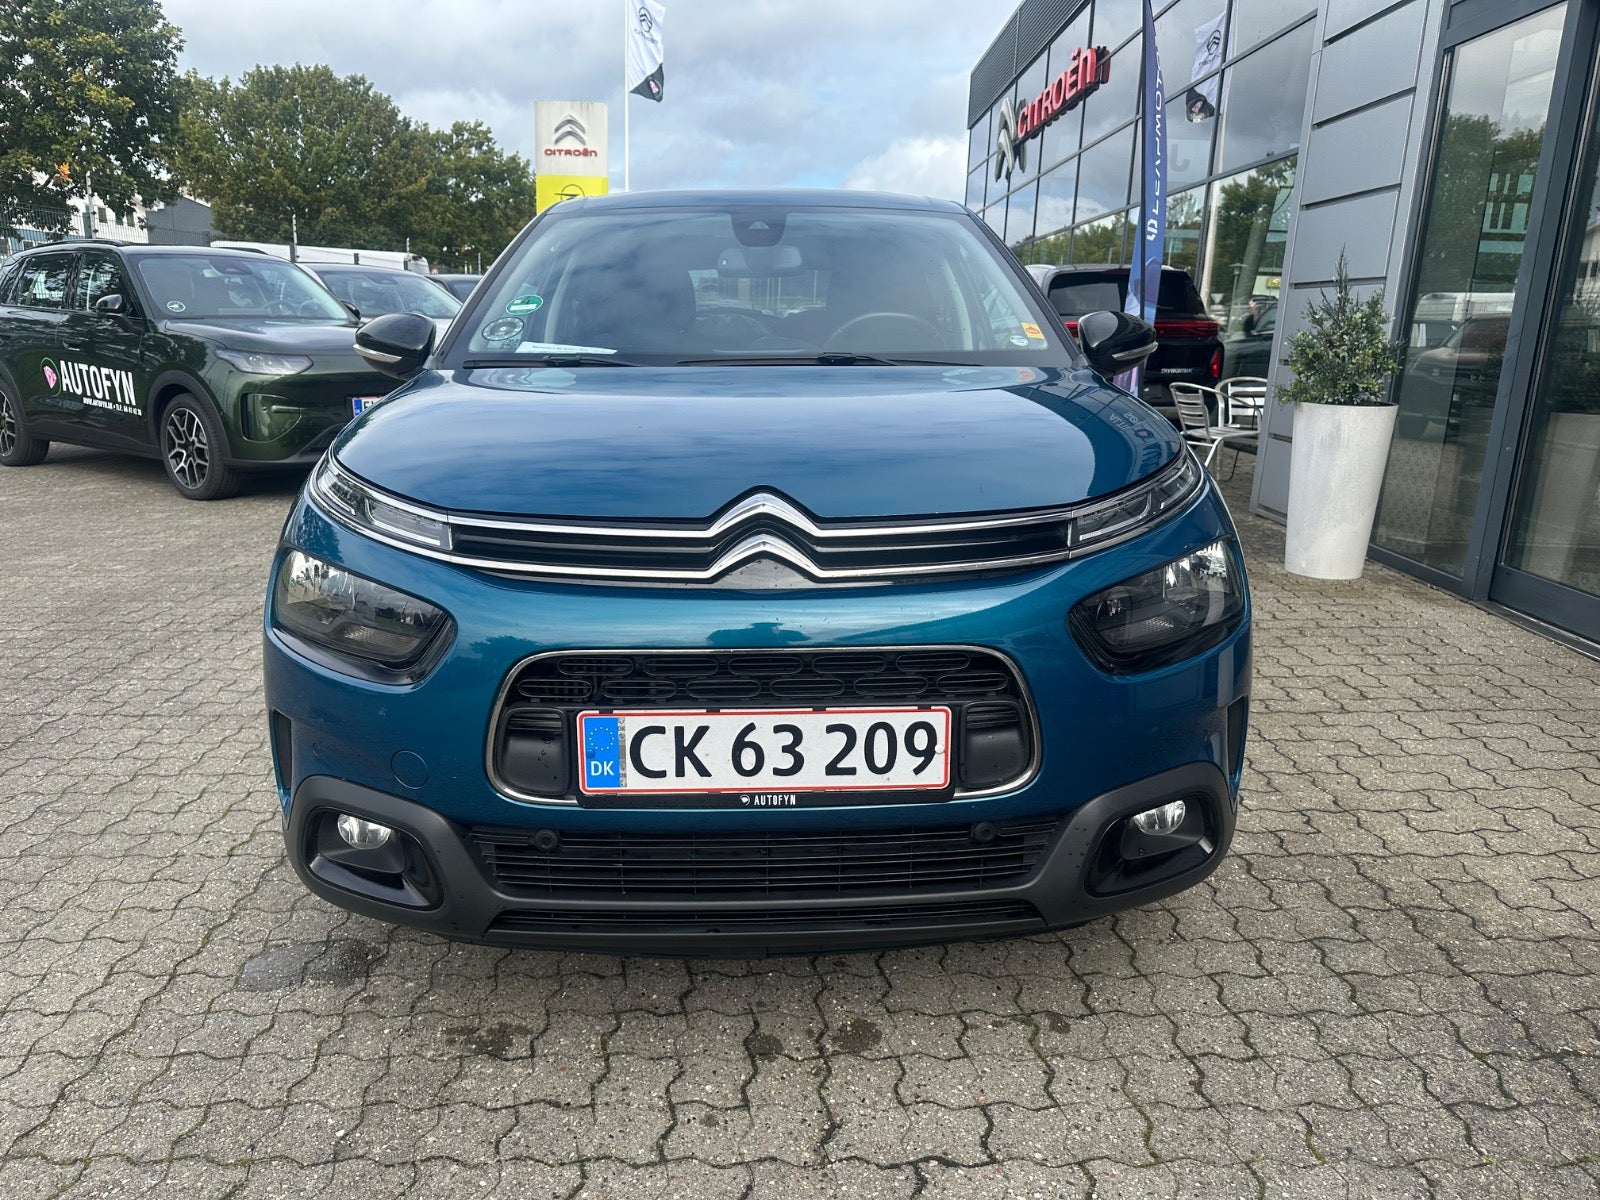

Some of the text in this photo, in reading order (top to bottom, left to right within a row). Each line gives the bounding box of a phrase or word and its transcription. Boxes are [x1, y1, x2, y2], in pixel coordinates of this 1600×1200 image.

[60, 360, 137, 406] AUTOFYN
[629, 725, 712, 779] CK
[731, 722, 805, 778] 63
[825, 721, 938, 776] 209
[590, 760, 614, 777] DK
[754, 794, 796, 806] AUTOFYN
